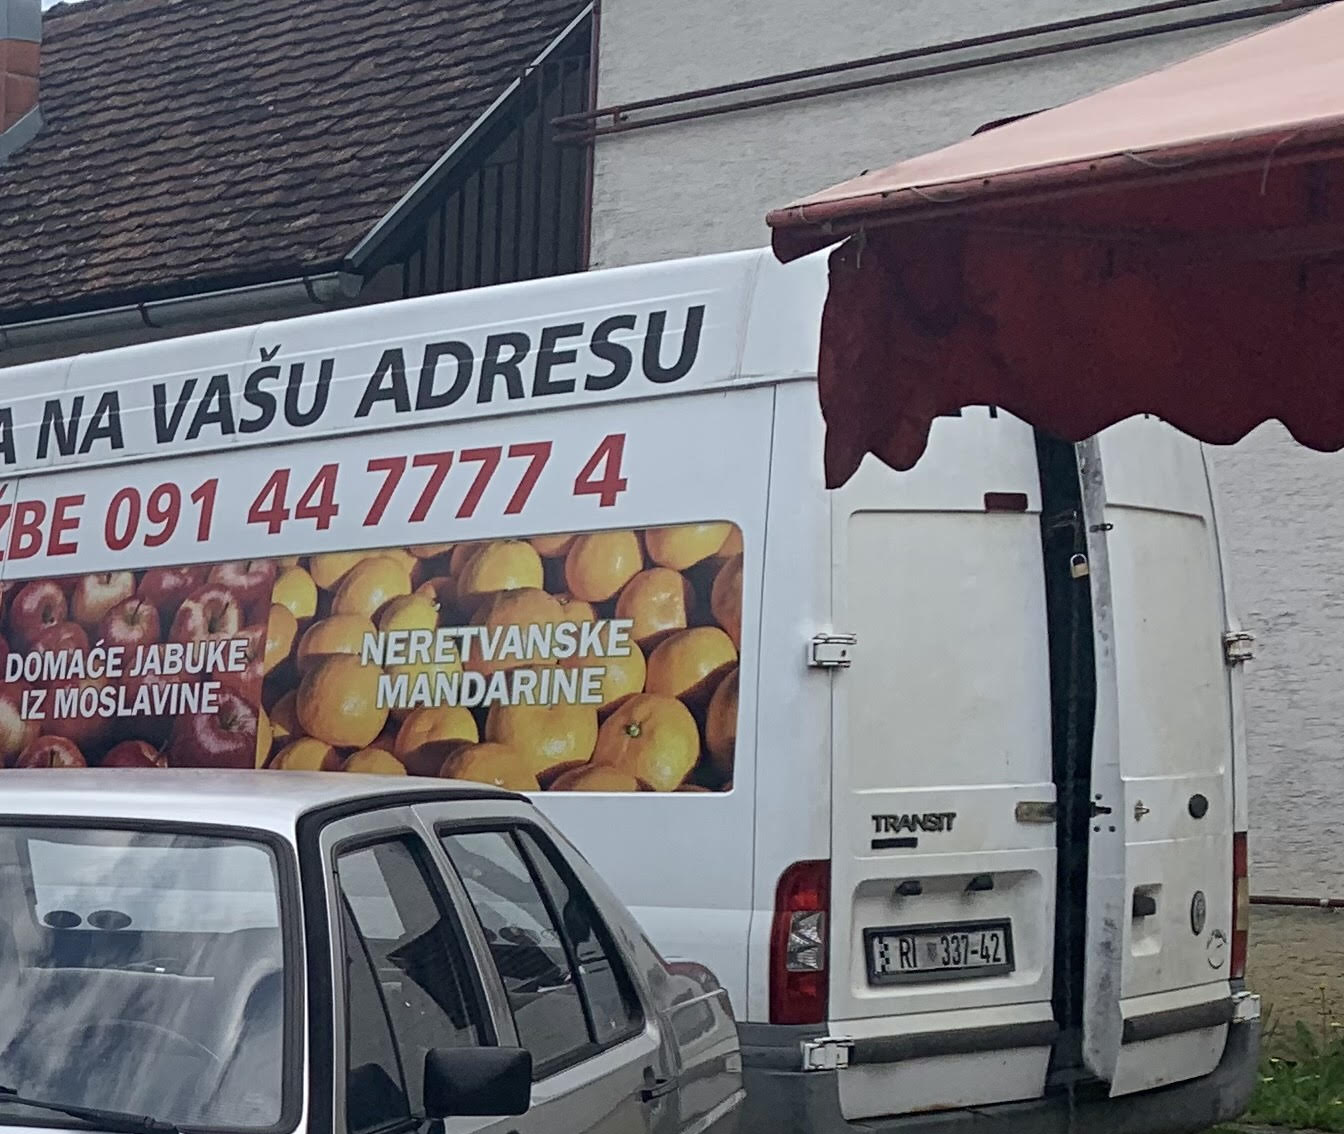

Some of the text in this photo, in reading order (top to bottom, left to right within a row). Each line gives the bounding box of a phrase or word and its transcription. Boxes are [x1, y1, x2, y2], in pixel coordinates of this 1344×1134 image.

[36, 390, 124, 459] NA
[153, 344, 335, 444] VAŠU
[354, 305, 706, 418] ADRESU
[104, 478, 219, 551] 091
[246, 463, 339, 534] 44
[363, 441, 552, 527] 7777
[572, 433, 627, 507] 4
[4, 639, 249, 683] DOMAĆE JABUKE
[361, 619, 634, 666] NERETVANSKE
[20, 681, 221, 720] IZ MOSLAVINE
[376, 667, 606, 709] MANDARINE
[871, 812, 957, 833] TRANSIT
[899, 932, 1001, 969] RI 337-42
